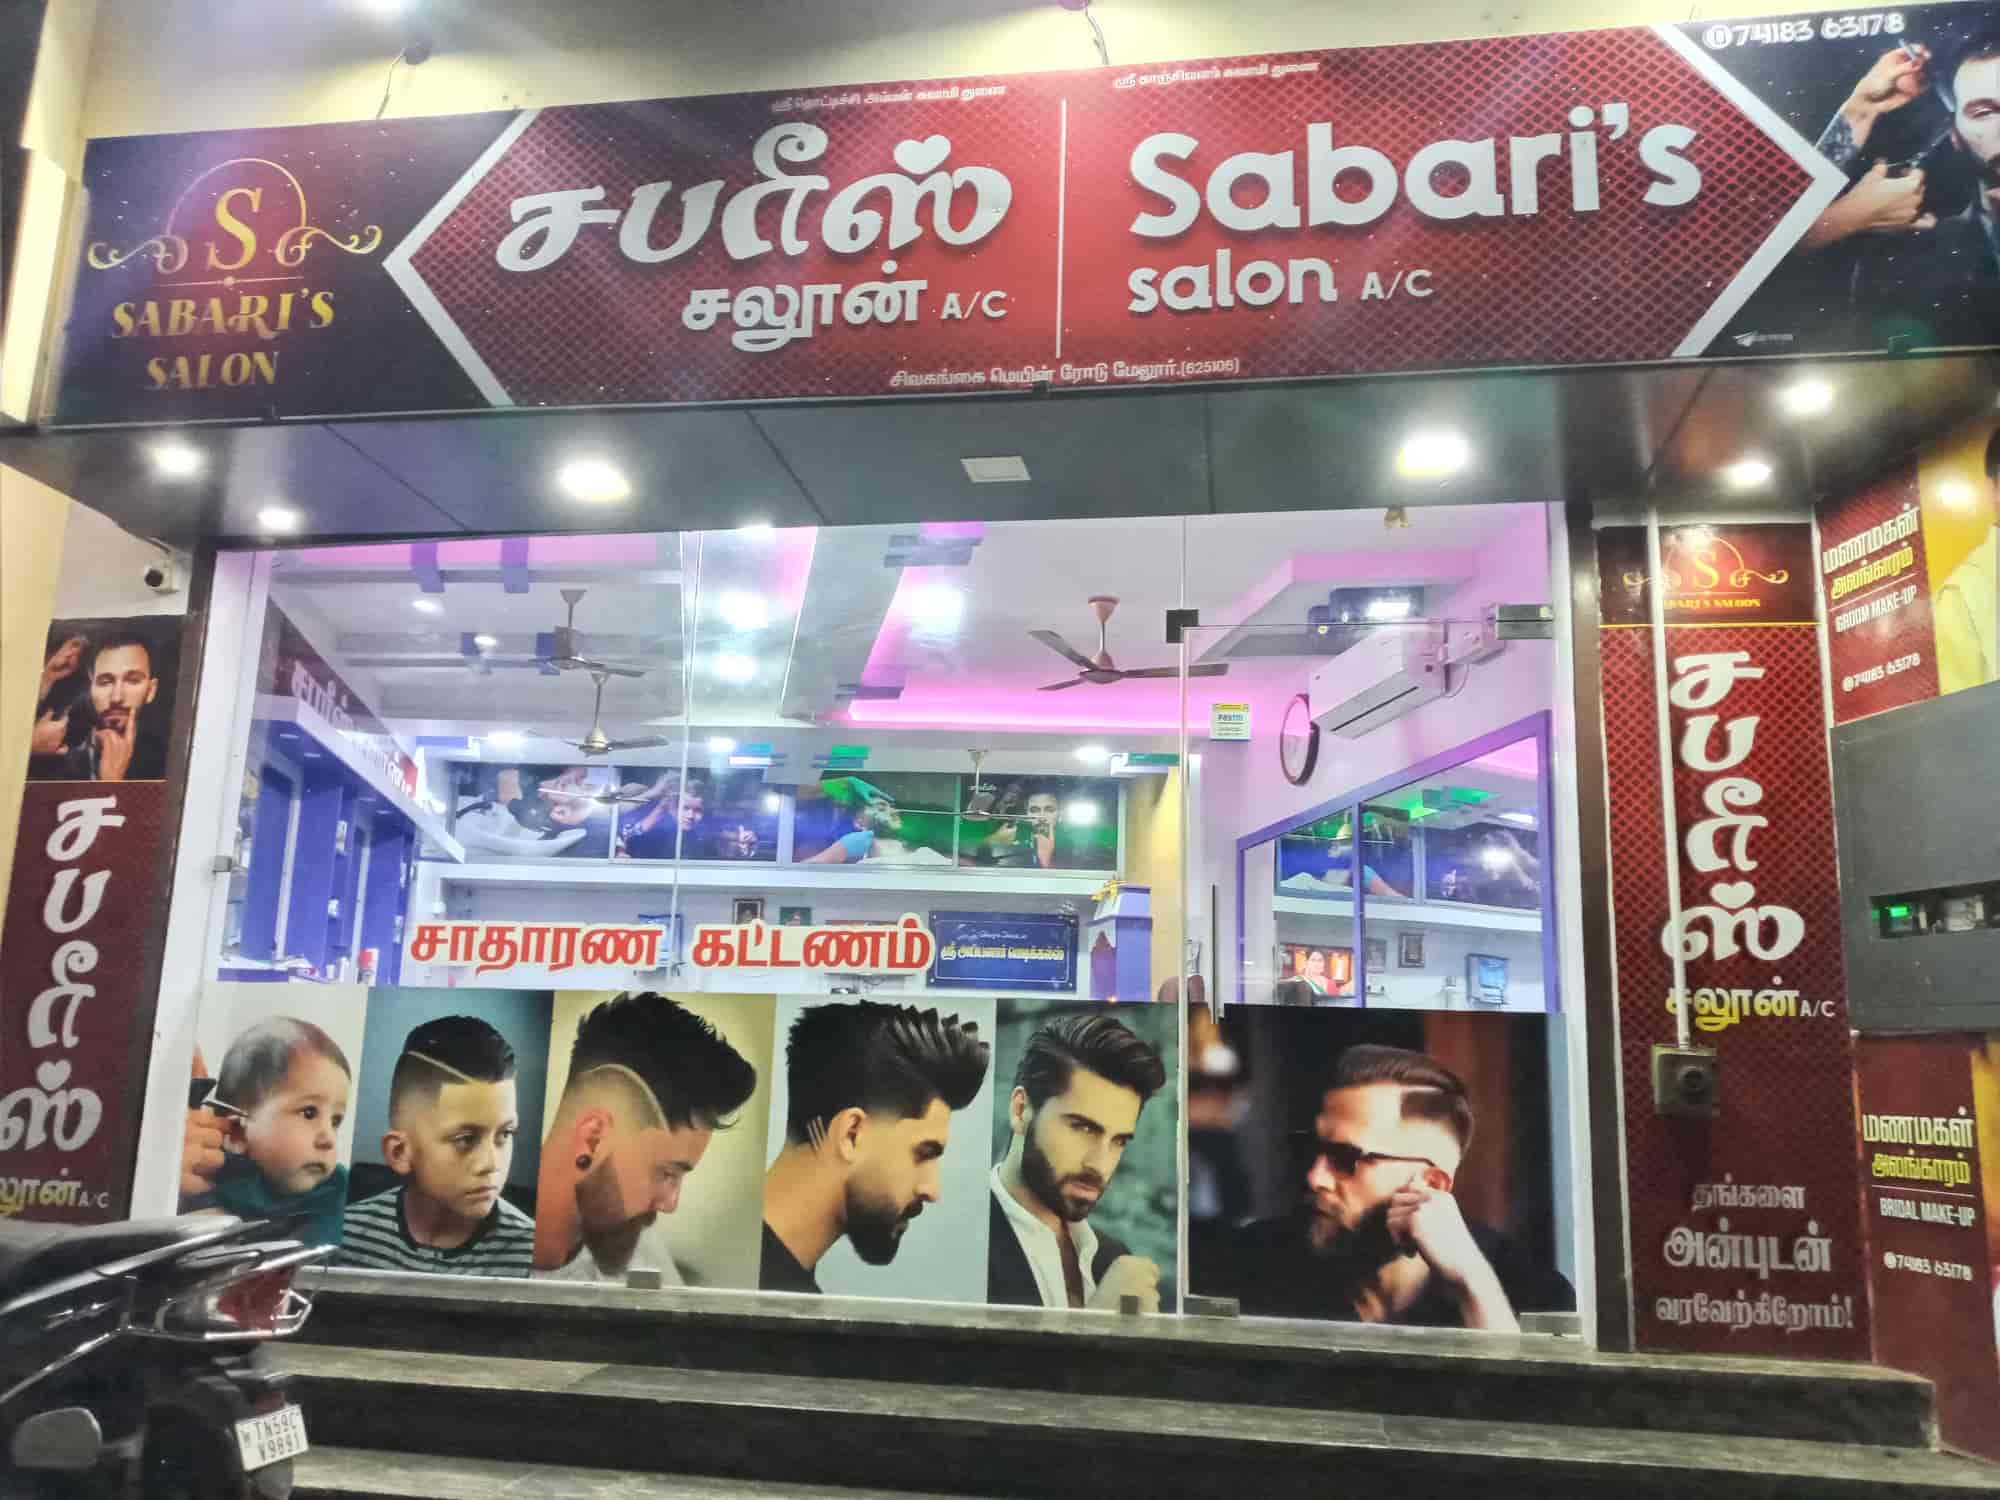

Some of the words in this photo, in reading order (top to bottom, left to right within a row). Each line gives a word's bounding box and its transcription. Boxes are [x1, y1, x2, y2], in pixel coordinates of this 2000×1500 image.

[1732, 17, 1814, 43] 74183
[1821, 13, 1905, 40] 63178
[1128, 102, 1702, 238] Sabari's
[495, 121, 1013, 273] சபரீஸ்
[1127, 247, 1338, 314] salon
[1360, 268, 1434, 301] A/C
[111, 286, 335, 340] SABARI'S
[681, 259, 928, 353] சலூன்
[939, 289, 1009, 321] A/C
[1060, 362, 1107, 382] ரோடு
[1836, 606, 1871, 632] GROOM
[1871, 585, 1918, 620] MAKE-UP
[410, 924, 664, 977] சாதாரண
[692, 917, 931, 970] கட்டணம்
[1800, 1000, 1836, 1018] A/C
[1692, 1172, 1806, 1212] தங்களை
[1879, 1197, 1920, 1221] BRIDAL
[1920, 1201, 1976, 1227] MAKE-UP
[1663, 1216, 1833, 1280] அன்புடன்
[1655, 1289, 1854, 1335] வரவேற்கிறோம்!
